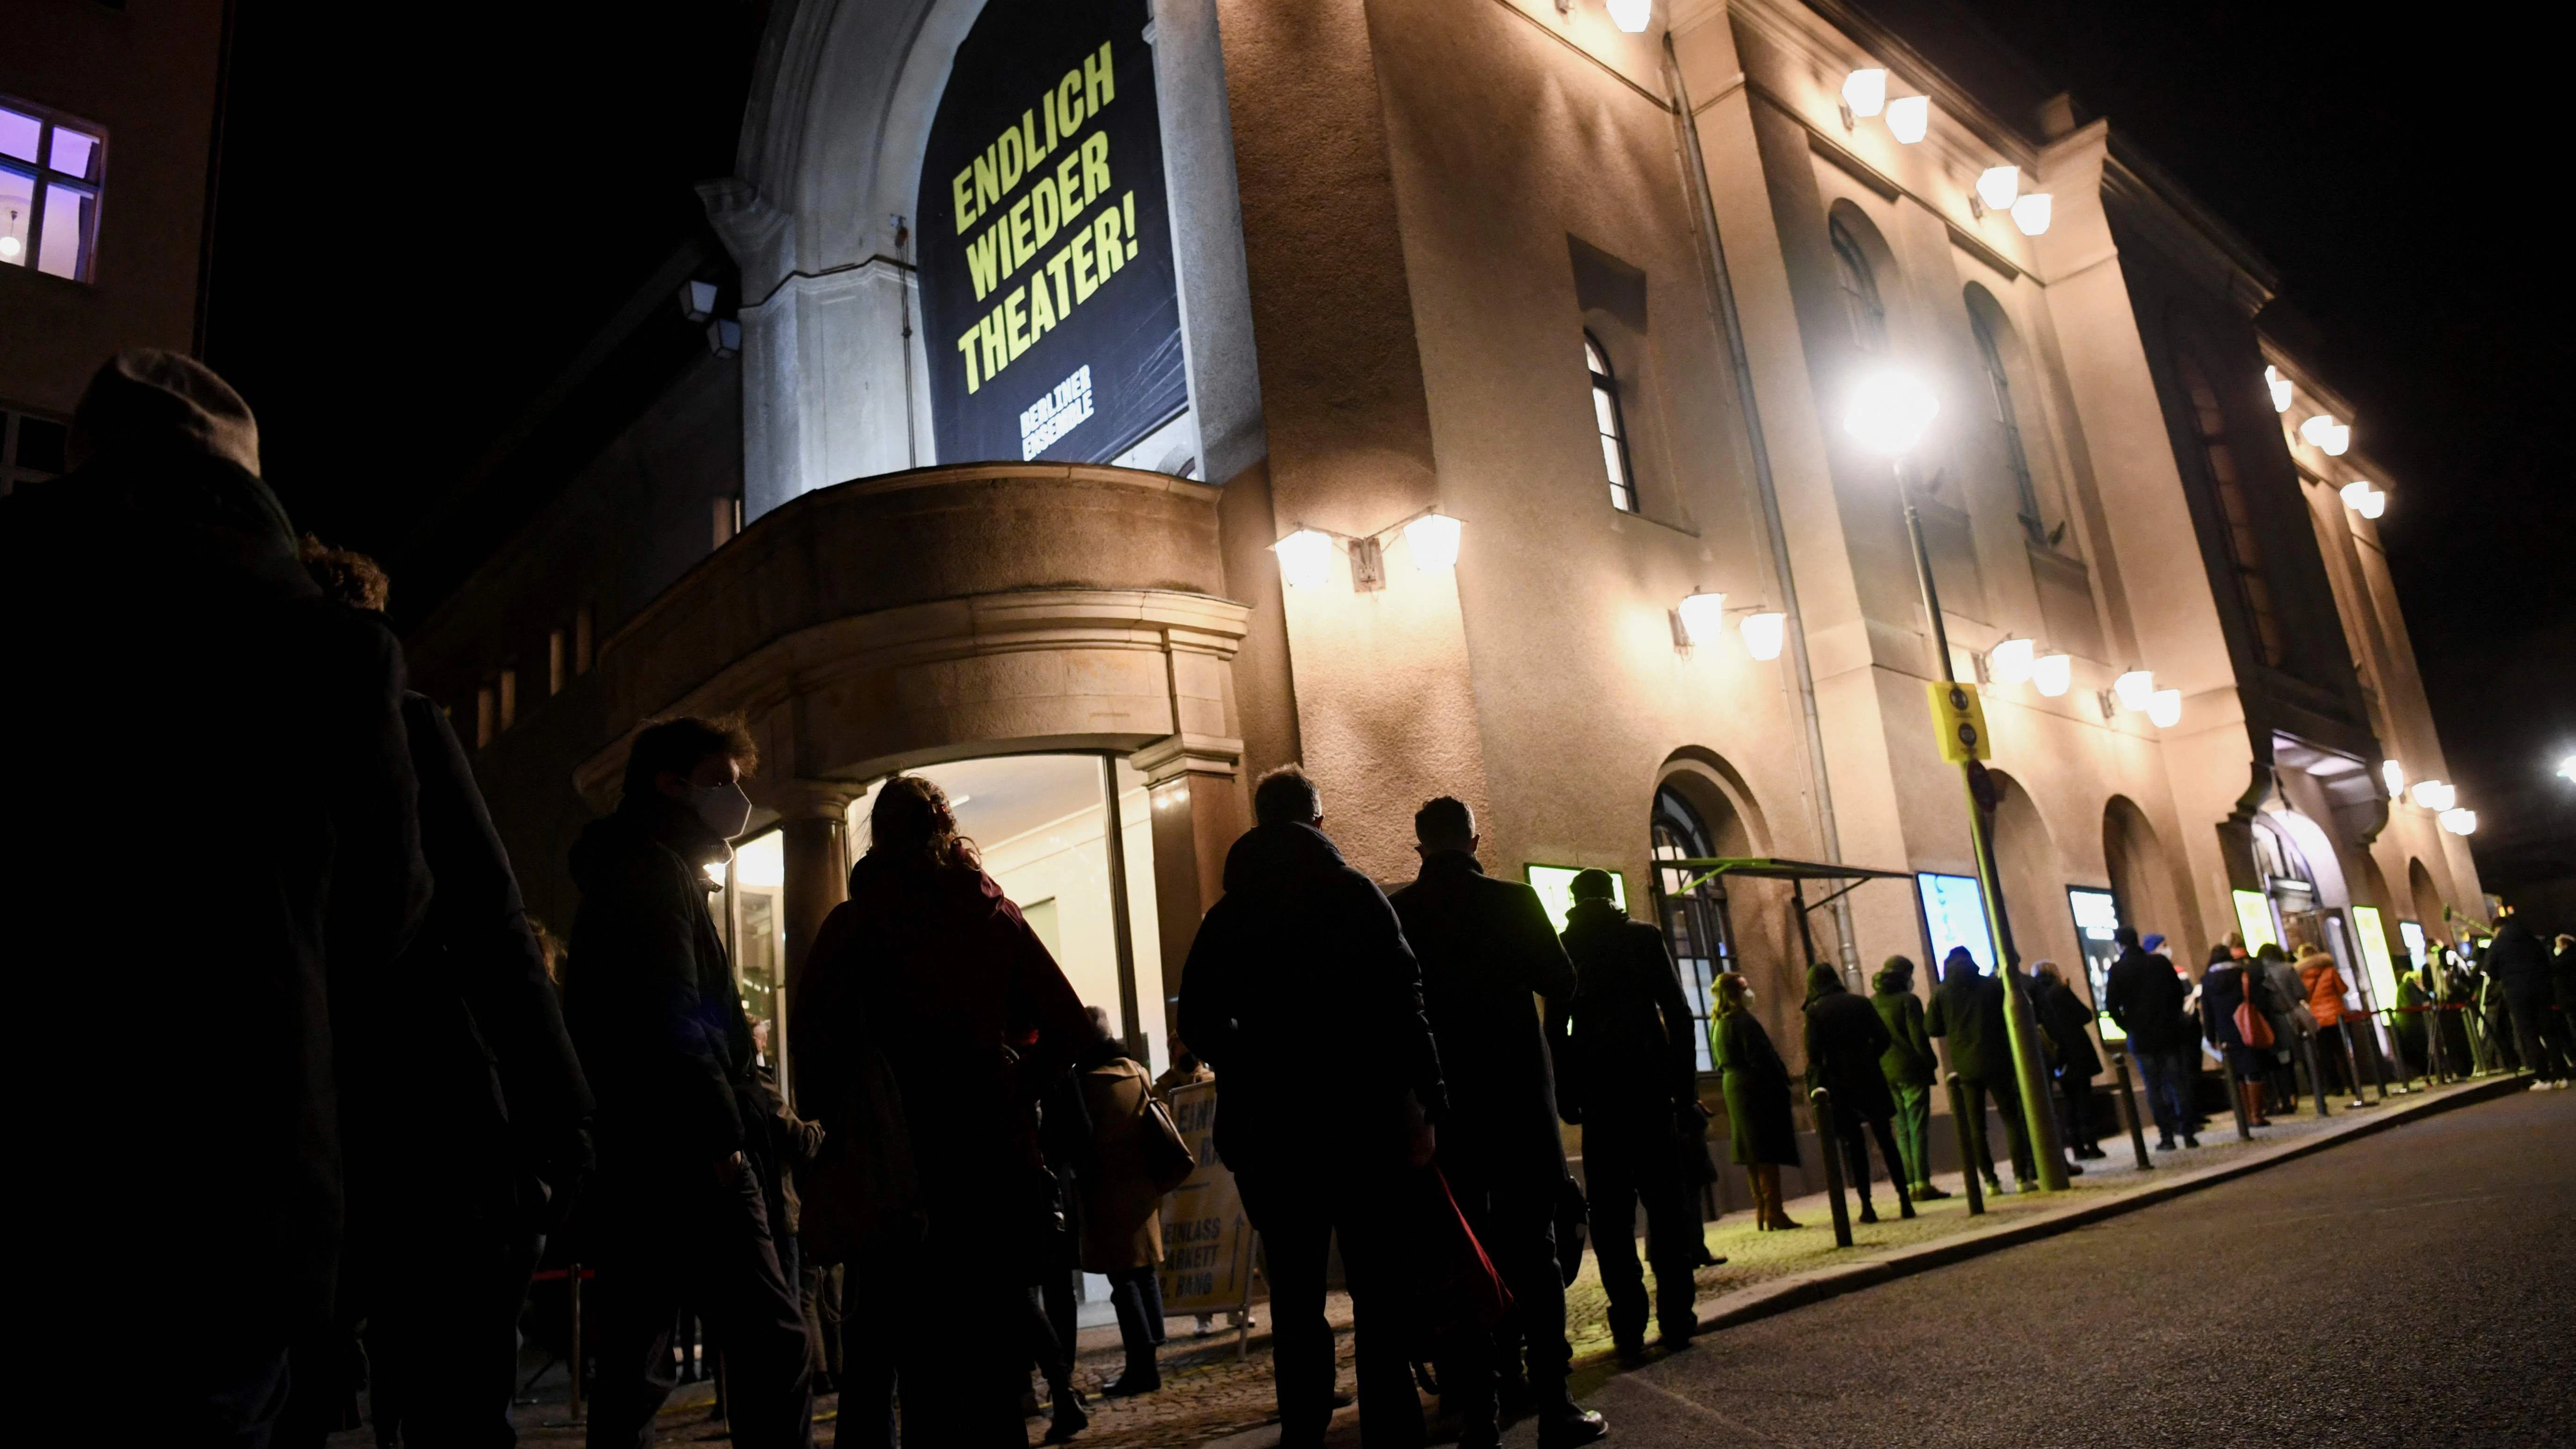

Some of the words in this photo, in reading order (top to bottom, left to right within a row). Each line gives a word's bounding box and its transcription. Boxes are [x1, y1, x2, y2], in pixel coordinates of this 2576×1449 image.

[952, 40, 1115, 236] ENDLICH
[966, 130, 1111, 302] WIEDER
[957, 190, 1138, 395] THEATER!
[1020, 364, 1092, 439] BERLINER
[1022, 389, 1095, 462] ENSEMBLE
[1164, 1217, 1221, 1244] EINLASS
